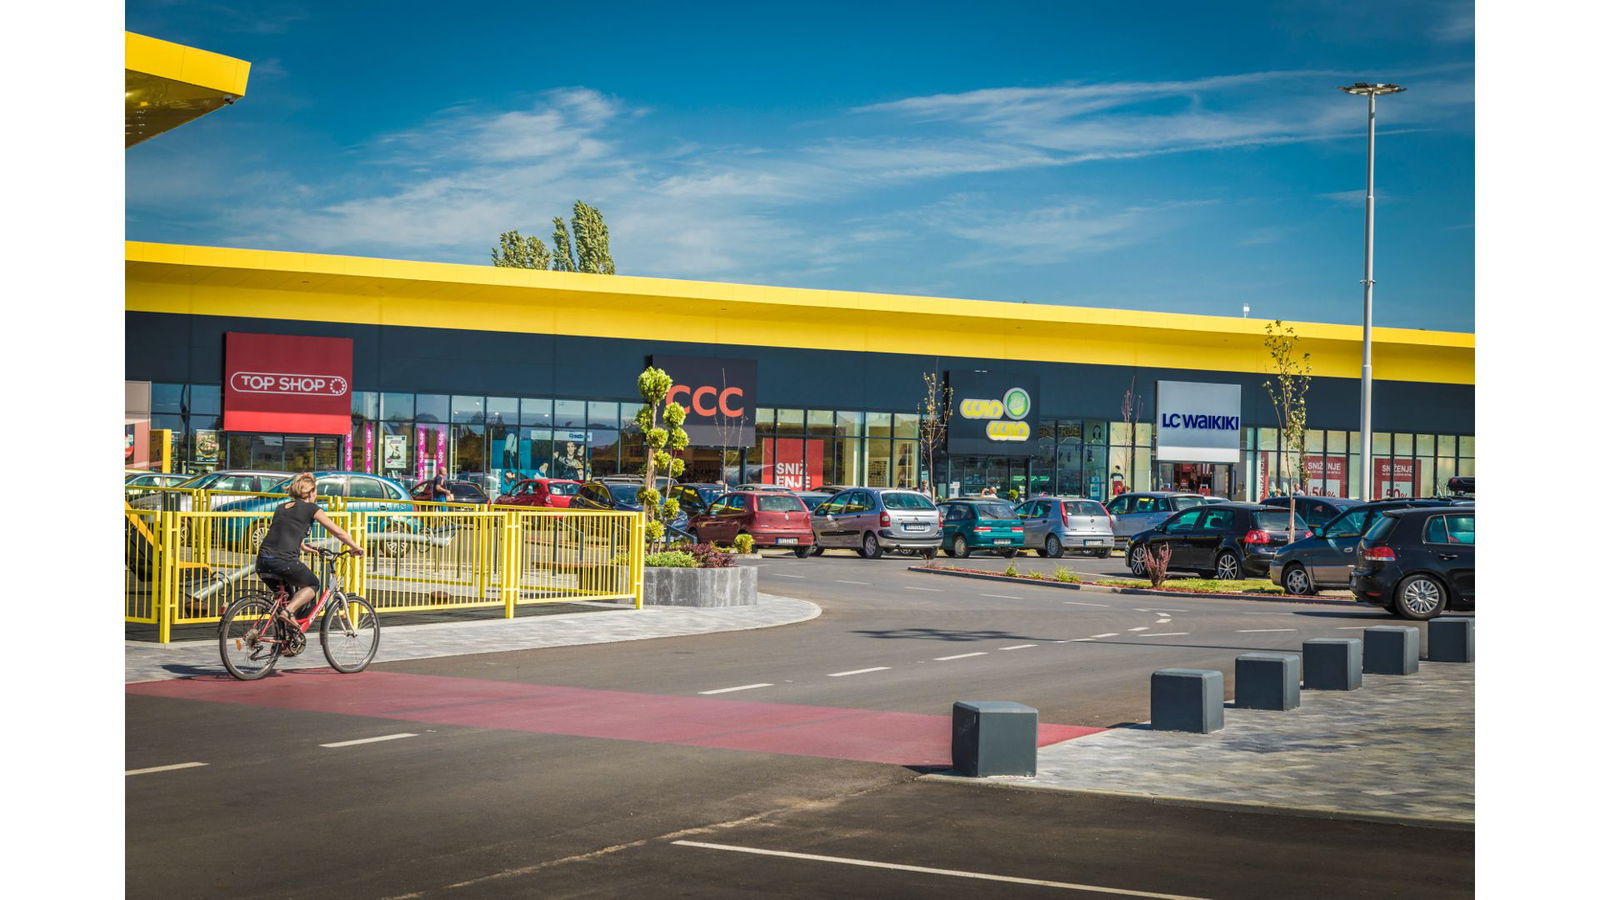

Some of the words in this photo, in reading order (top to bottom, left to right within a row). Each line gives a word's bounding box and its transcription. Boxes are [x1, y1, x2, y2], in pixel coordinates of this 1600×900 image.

[241, 375, 275, 390] TOP
[279, 377, 325, 391] SHOP
[665, 384, 744, 417] CCC
[1162, 413, 1180, 428] LC
[1307, 461, 1341, 471] SNIŽNJE
[1382, 464, 1412, 473] SNŽENJE
[776, 476, 811, 488] ENJE
